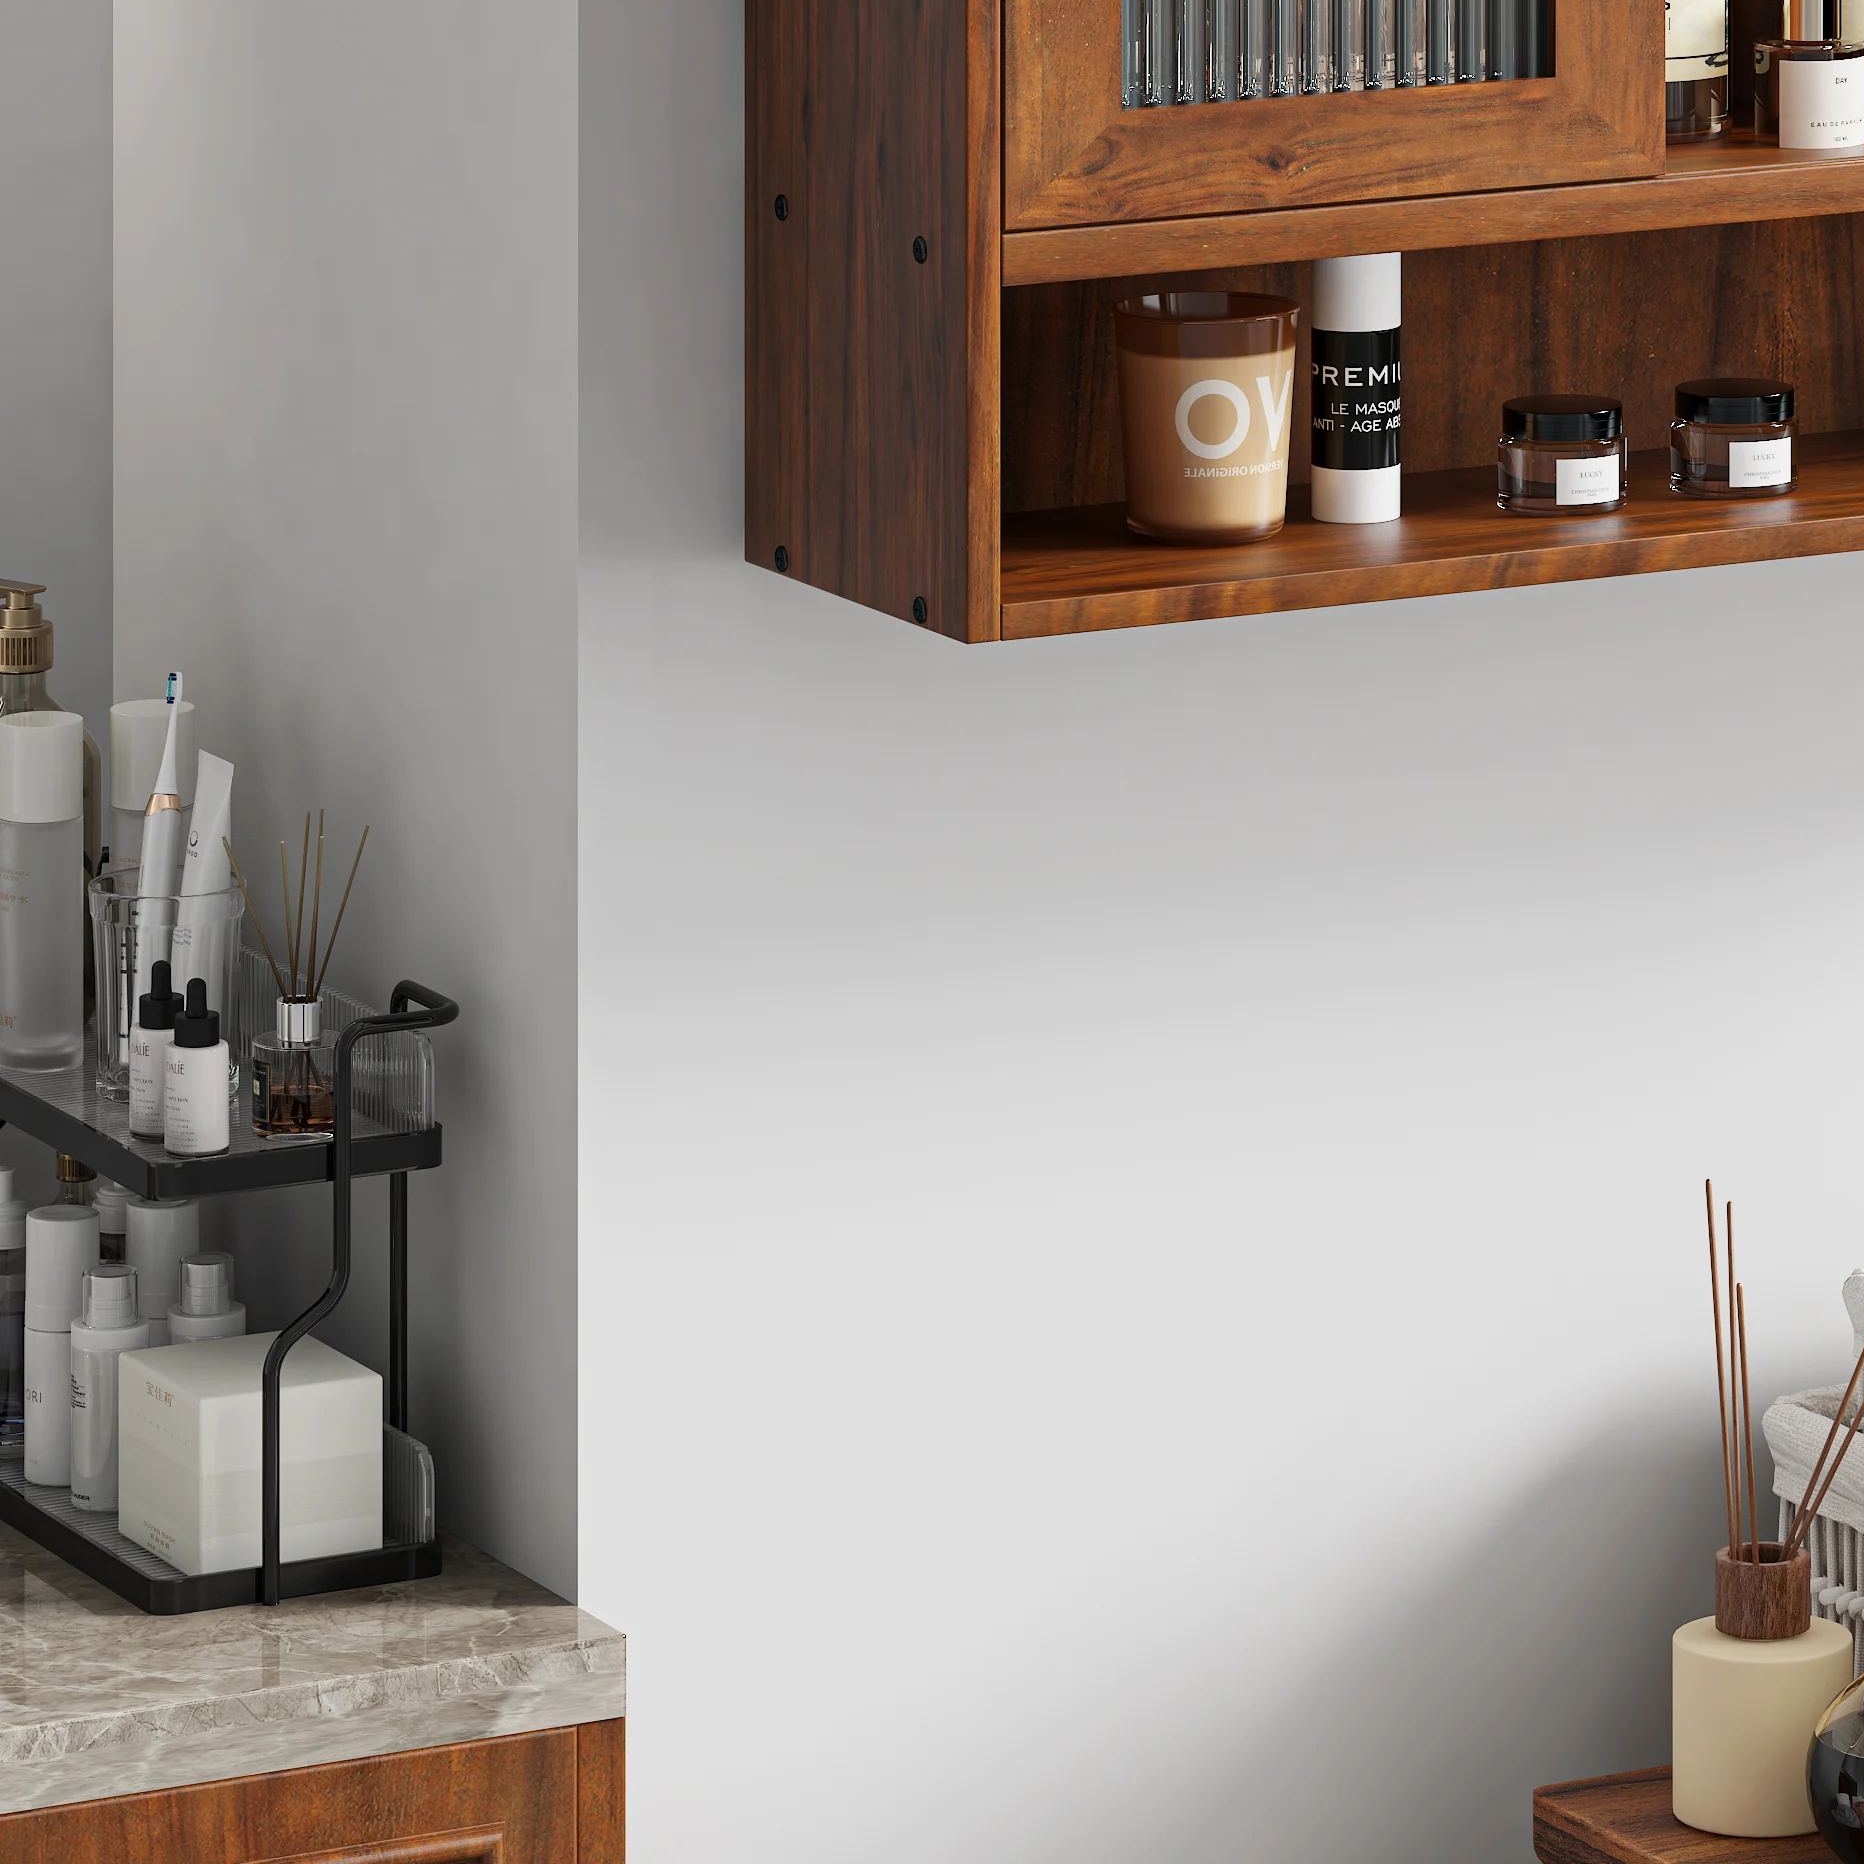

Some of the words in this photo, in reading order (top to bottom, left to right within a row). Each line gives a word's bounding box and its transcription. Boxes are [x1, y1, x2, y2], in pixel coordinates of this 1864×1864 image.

[1835, 77, 1848, 85] DAY
[1331, 402, 1349, 415] LE
[1313, 417, 1334, 432] ANTI
[1350, 419, 1382, 432] AGE
[1753, 452, 1775, 461] LUCKY
[1580, 470, 1603, 478] LUCKY
[72, 1492, 90, 1501] AUDER
